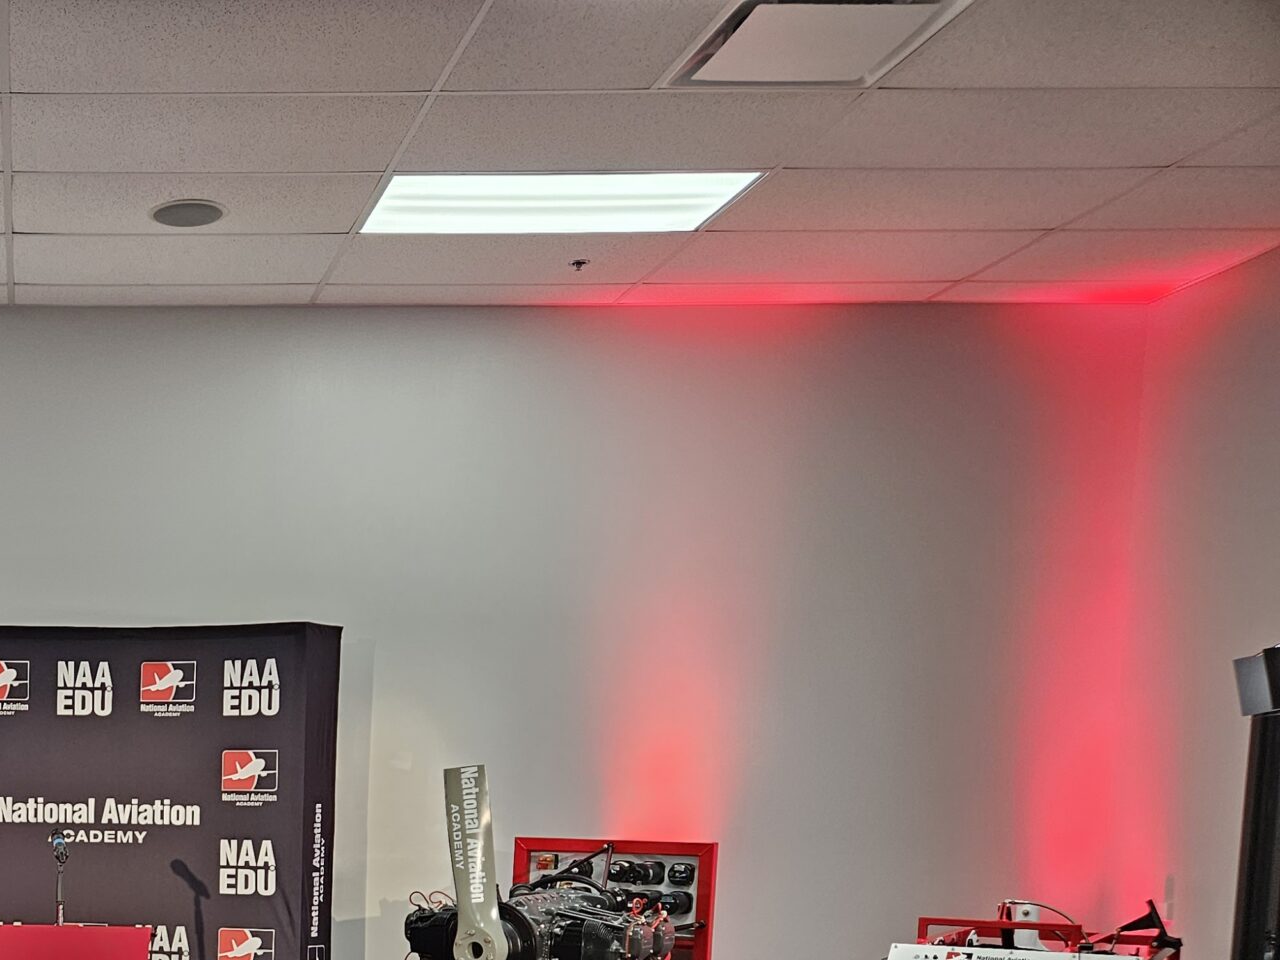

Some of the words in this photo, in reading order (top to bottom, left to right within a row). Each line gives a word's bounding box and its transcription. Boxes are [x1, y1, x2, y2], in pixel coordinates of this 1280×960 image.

[57, 660, 112, 688] NAA
[224, 658, 280, 686] NAA
[2, 702, 28, 711] Aviation
[56, 689, 112, 716] EDU
[140, 704, 166, 712] National
[168, 704, 194, 712] Aviation
[223, 688, 280, 716] EDU
[222, 793, 249, 801] National
[250, 794, 277, 802] Aviation
[460, 766, 480, 834] National
[101, 798, 200, 826] Aviation
[312, 804, 322, 868] Aviation
[451, 804, 464, 870] ACADEMY
[220, 840, 276, 866] NAA
[219, 868, 276, 896] EDU
[466, 838, 487, 904] Aviation
[310, 872, 320, 937] National
[135, 925, 190, 952] AA
